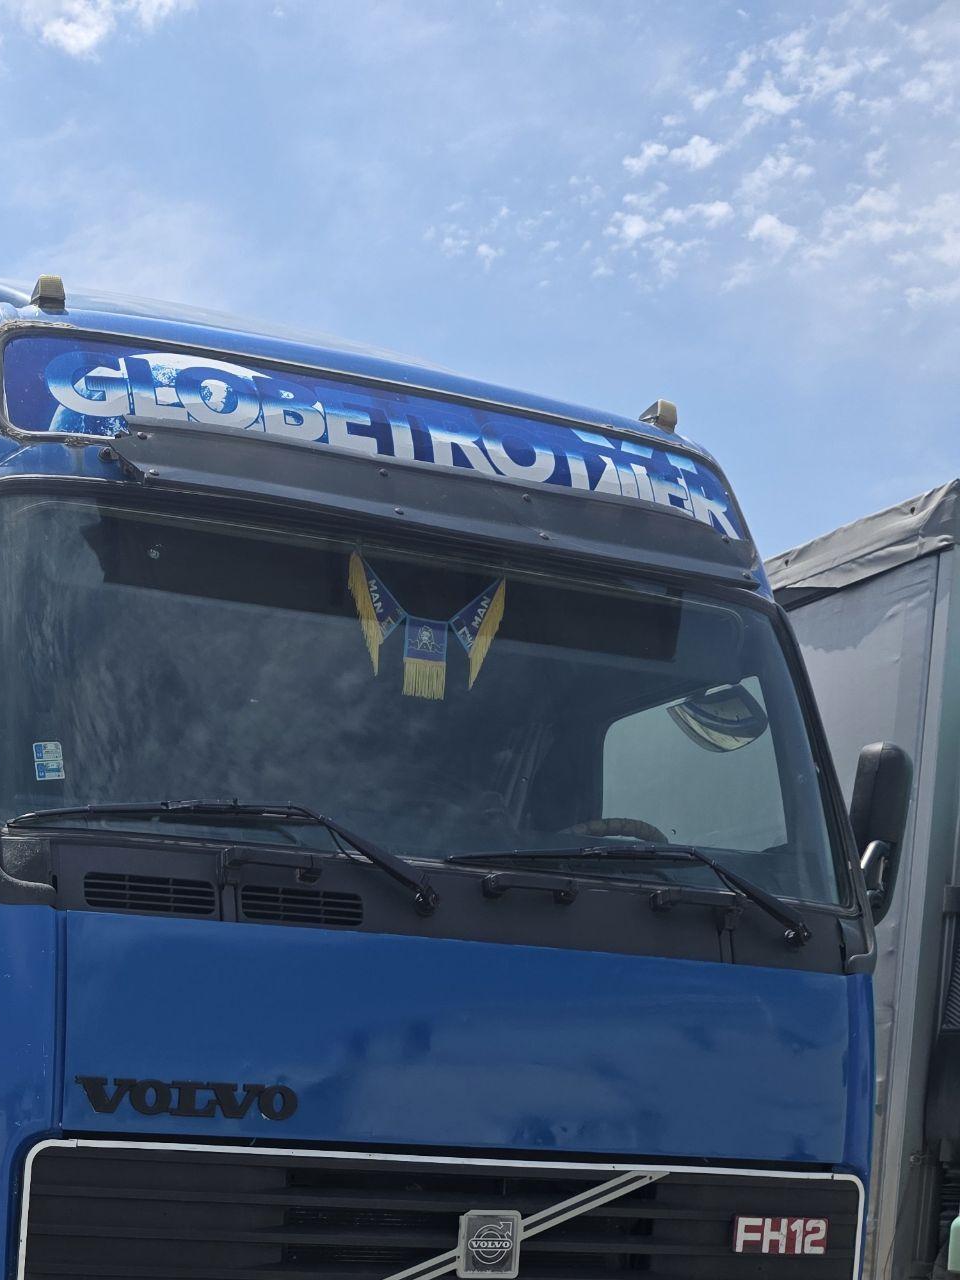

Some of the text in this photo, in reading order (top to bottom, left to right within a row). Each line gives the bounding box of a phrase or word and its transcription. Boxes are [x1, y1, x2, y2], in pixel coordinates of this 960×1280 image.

[368, 579, 383, 613] MAN
[472, 596, 490, 628] MAN
[75, 1075, 298, 1121] VOLVO
[470, 1240, 511, 1248] VOLVO
[735, 1217, 827, 1254] FH12
